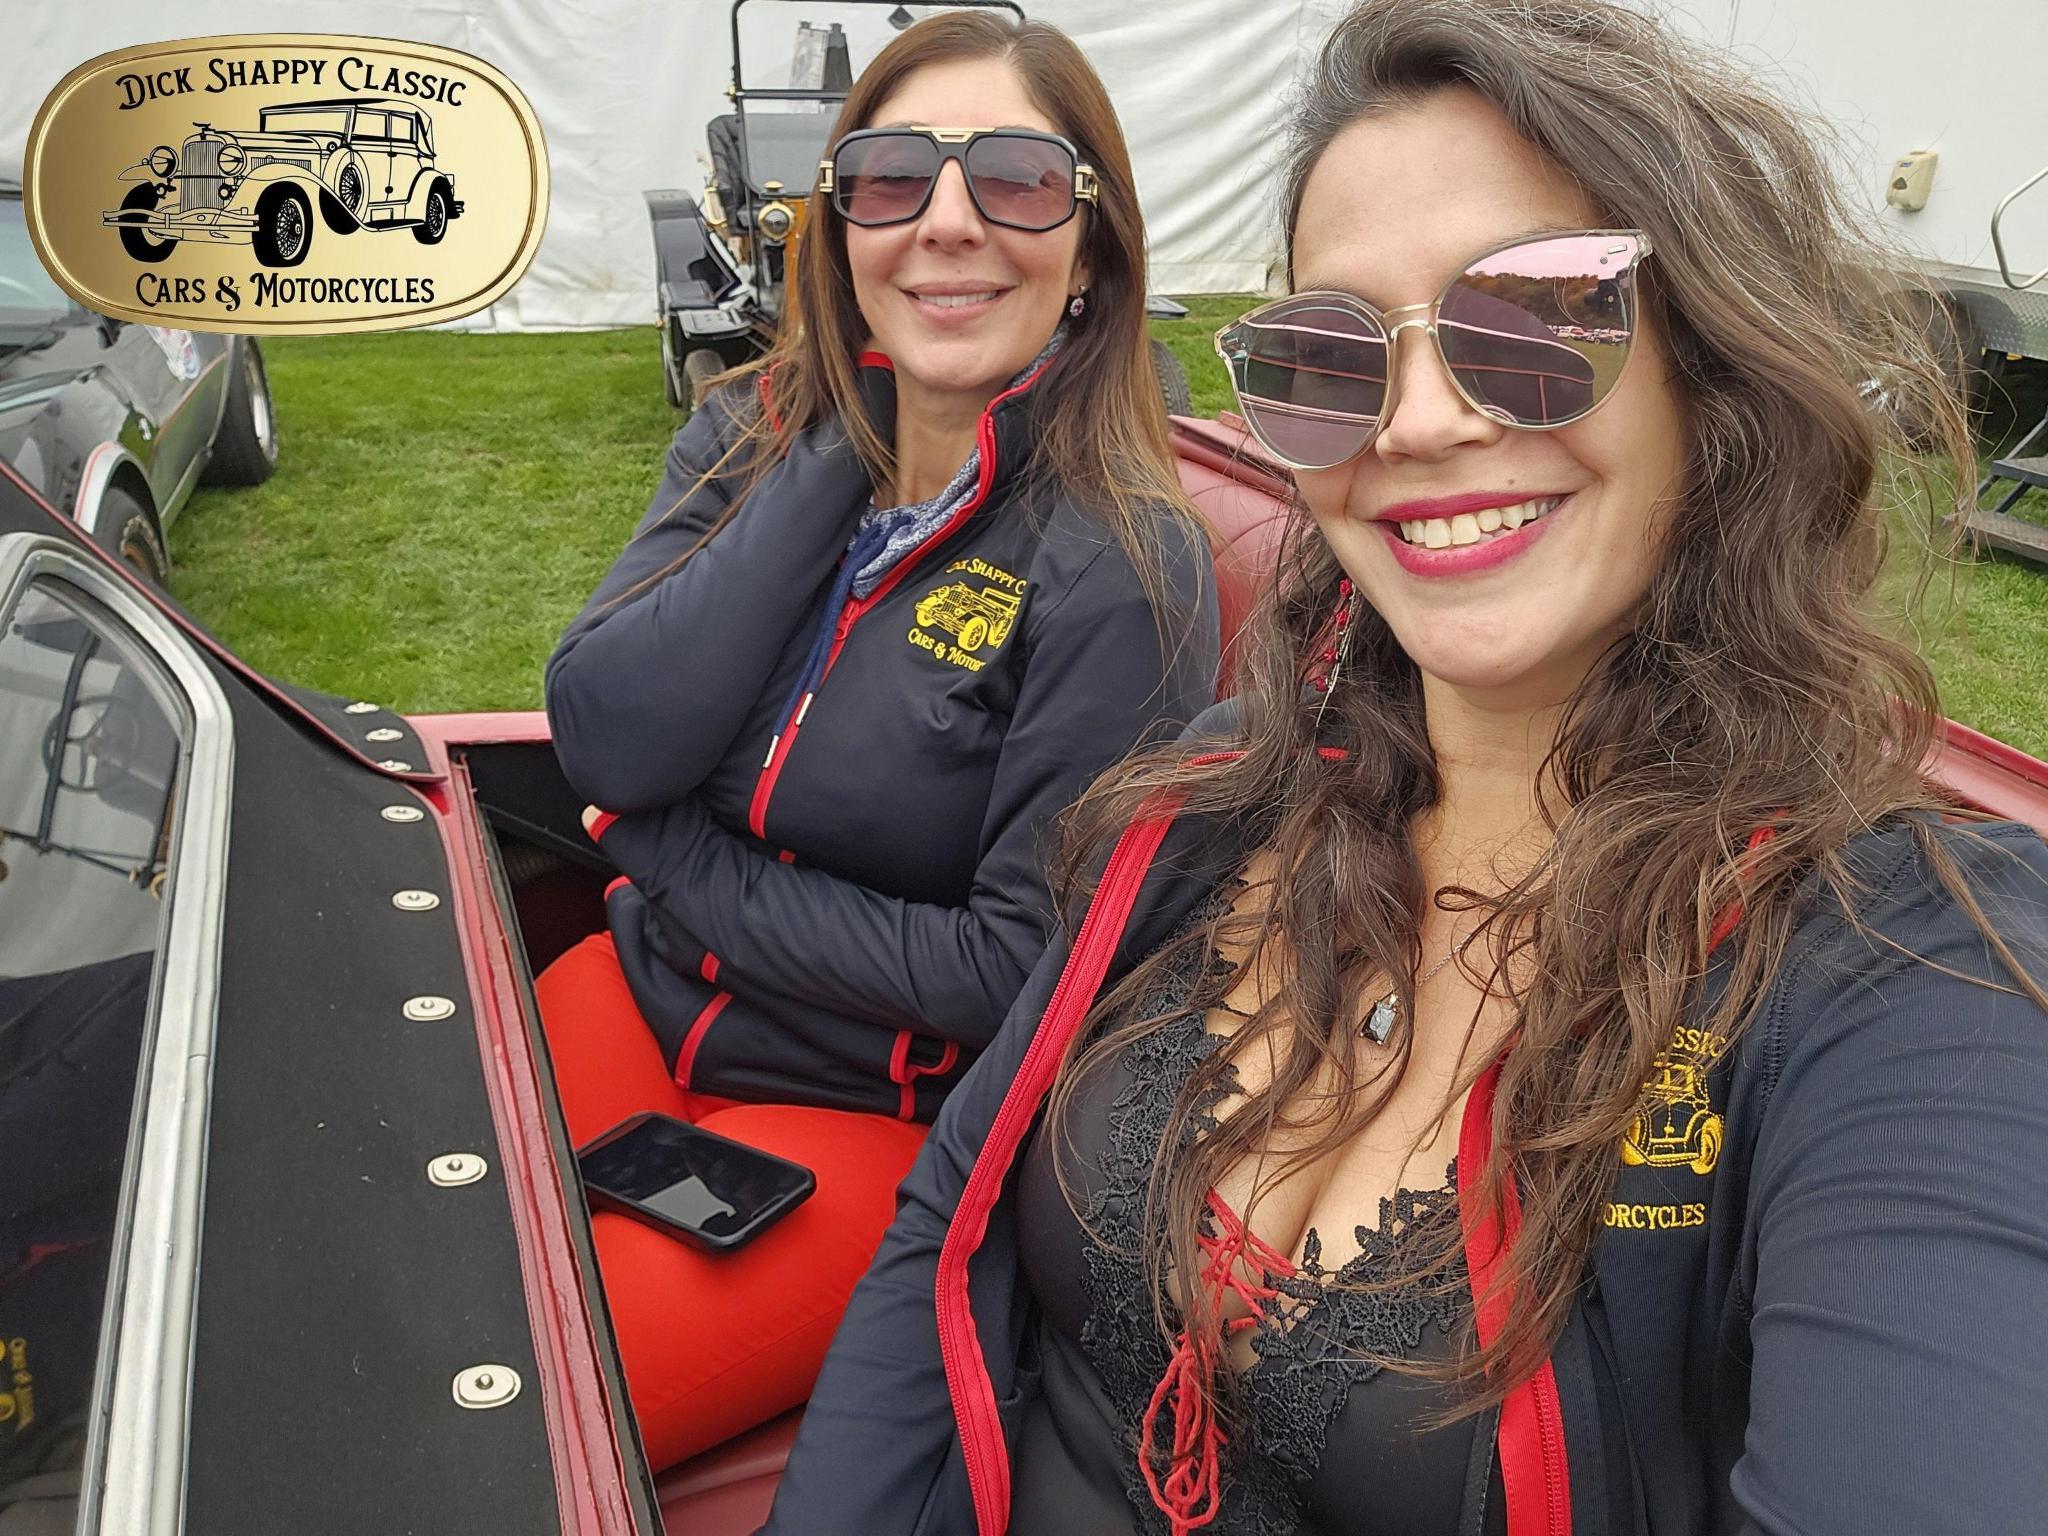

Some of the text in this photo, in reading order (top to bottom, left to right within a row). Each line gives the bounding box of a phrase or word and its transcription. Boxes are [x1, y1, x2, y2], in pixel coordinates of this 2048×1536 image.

[966, 558, 1017, 588] SHAPPY
[908, 627, 935, 650] CARS
[934, 642, 947, 660] &
[1672, 1025, 1727, 1057] SSIC
[1603, 1202, 1706, 1230] ORCYCLES
